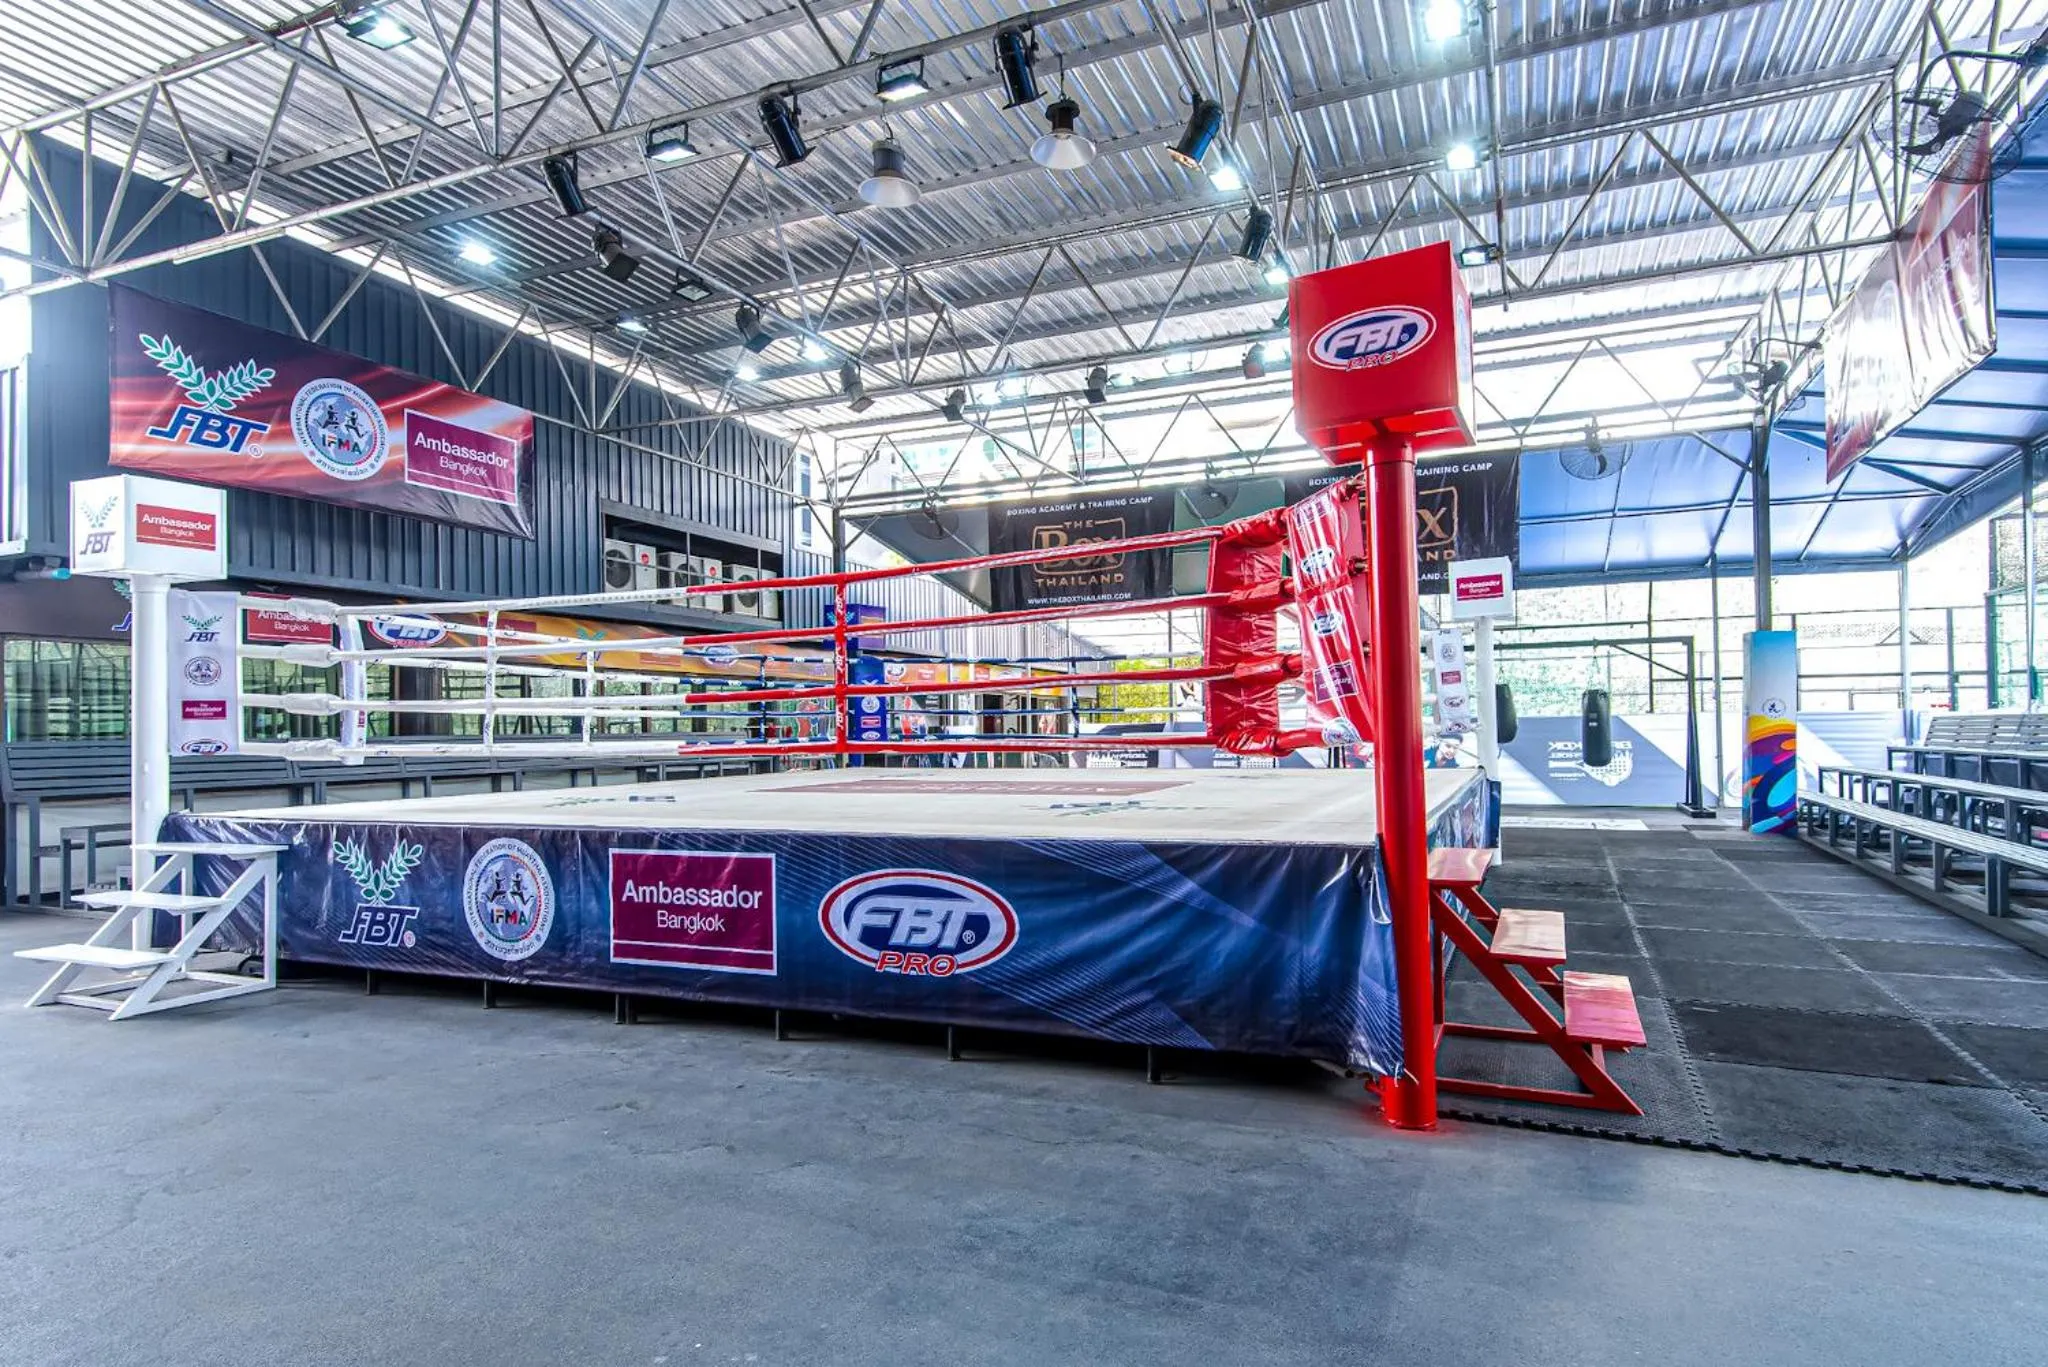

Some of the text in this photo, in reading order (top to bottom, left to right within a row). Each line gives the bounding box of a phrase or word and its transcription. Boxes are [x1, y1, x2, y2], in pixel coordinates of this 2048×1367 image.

[1327, 318, 1416, 357] FBT
[1346, 351, 1398, 371] PRO
[145, 403, 272, 455] FBT
[322, 433, 363, 455] IFMA
[414, 431, 509, 469] Ambassador
[439, 456, 488, 479] Bangkok
[1415, 462, 1493, 477] RAINING CAMP
[1006, 508, 1037, 517] BOXING
[1039, 503, 1078, 514] ACADEMY
[1088, 498, 1127, 509] TRAINING
[1129, 496, 1153, 505] CAMP
[142, 513, 213, 532] Ambassador
[160, 526, 195, 537] Bangkok
[1064, 519, 1094, 529] THE
[79, 531, 117, 555] FBT
[1035, 573, 1125, 588] THAILAND
[184, 631, 220, 642] FBT
[274, 621, 310, 633] Bangkok
[621, 879, 763, 909] Ambassador
[338, 902, 420, 947] FBT
[491, 906, 529, 926] IFMA
[657, 910, 726, 935] Bangkok
[848, 894, 988, 949] FBT
[874, 950, 959, 978] PRO
